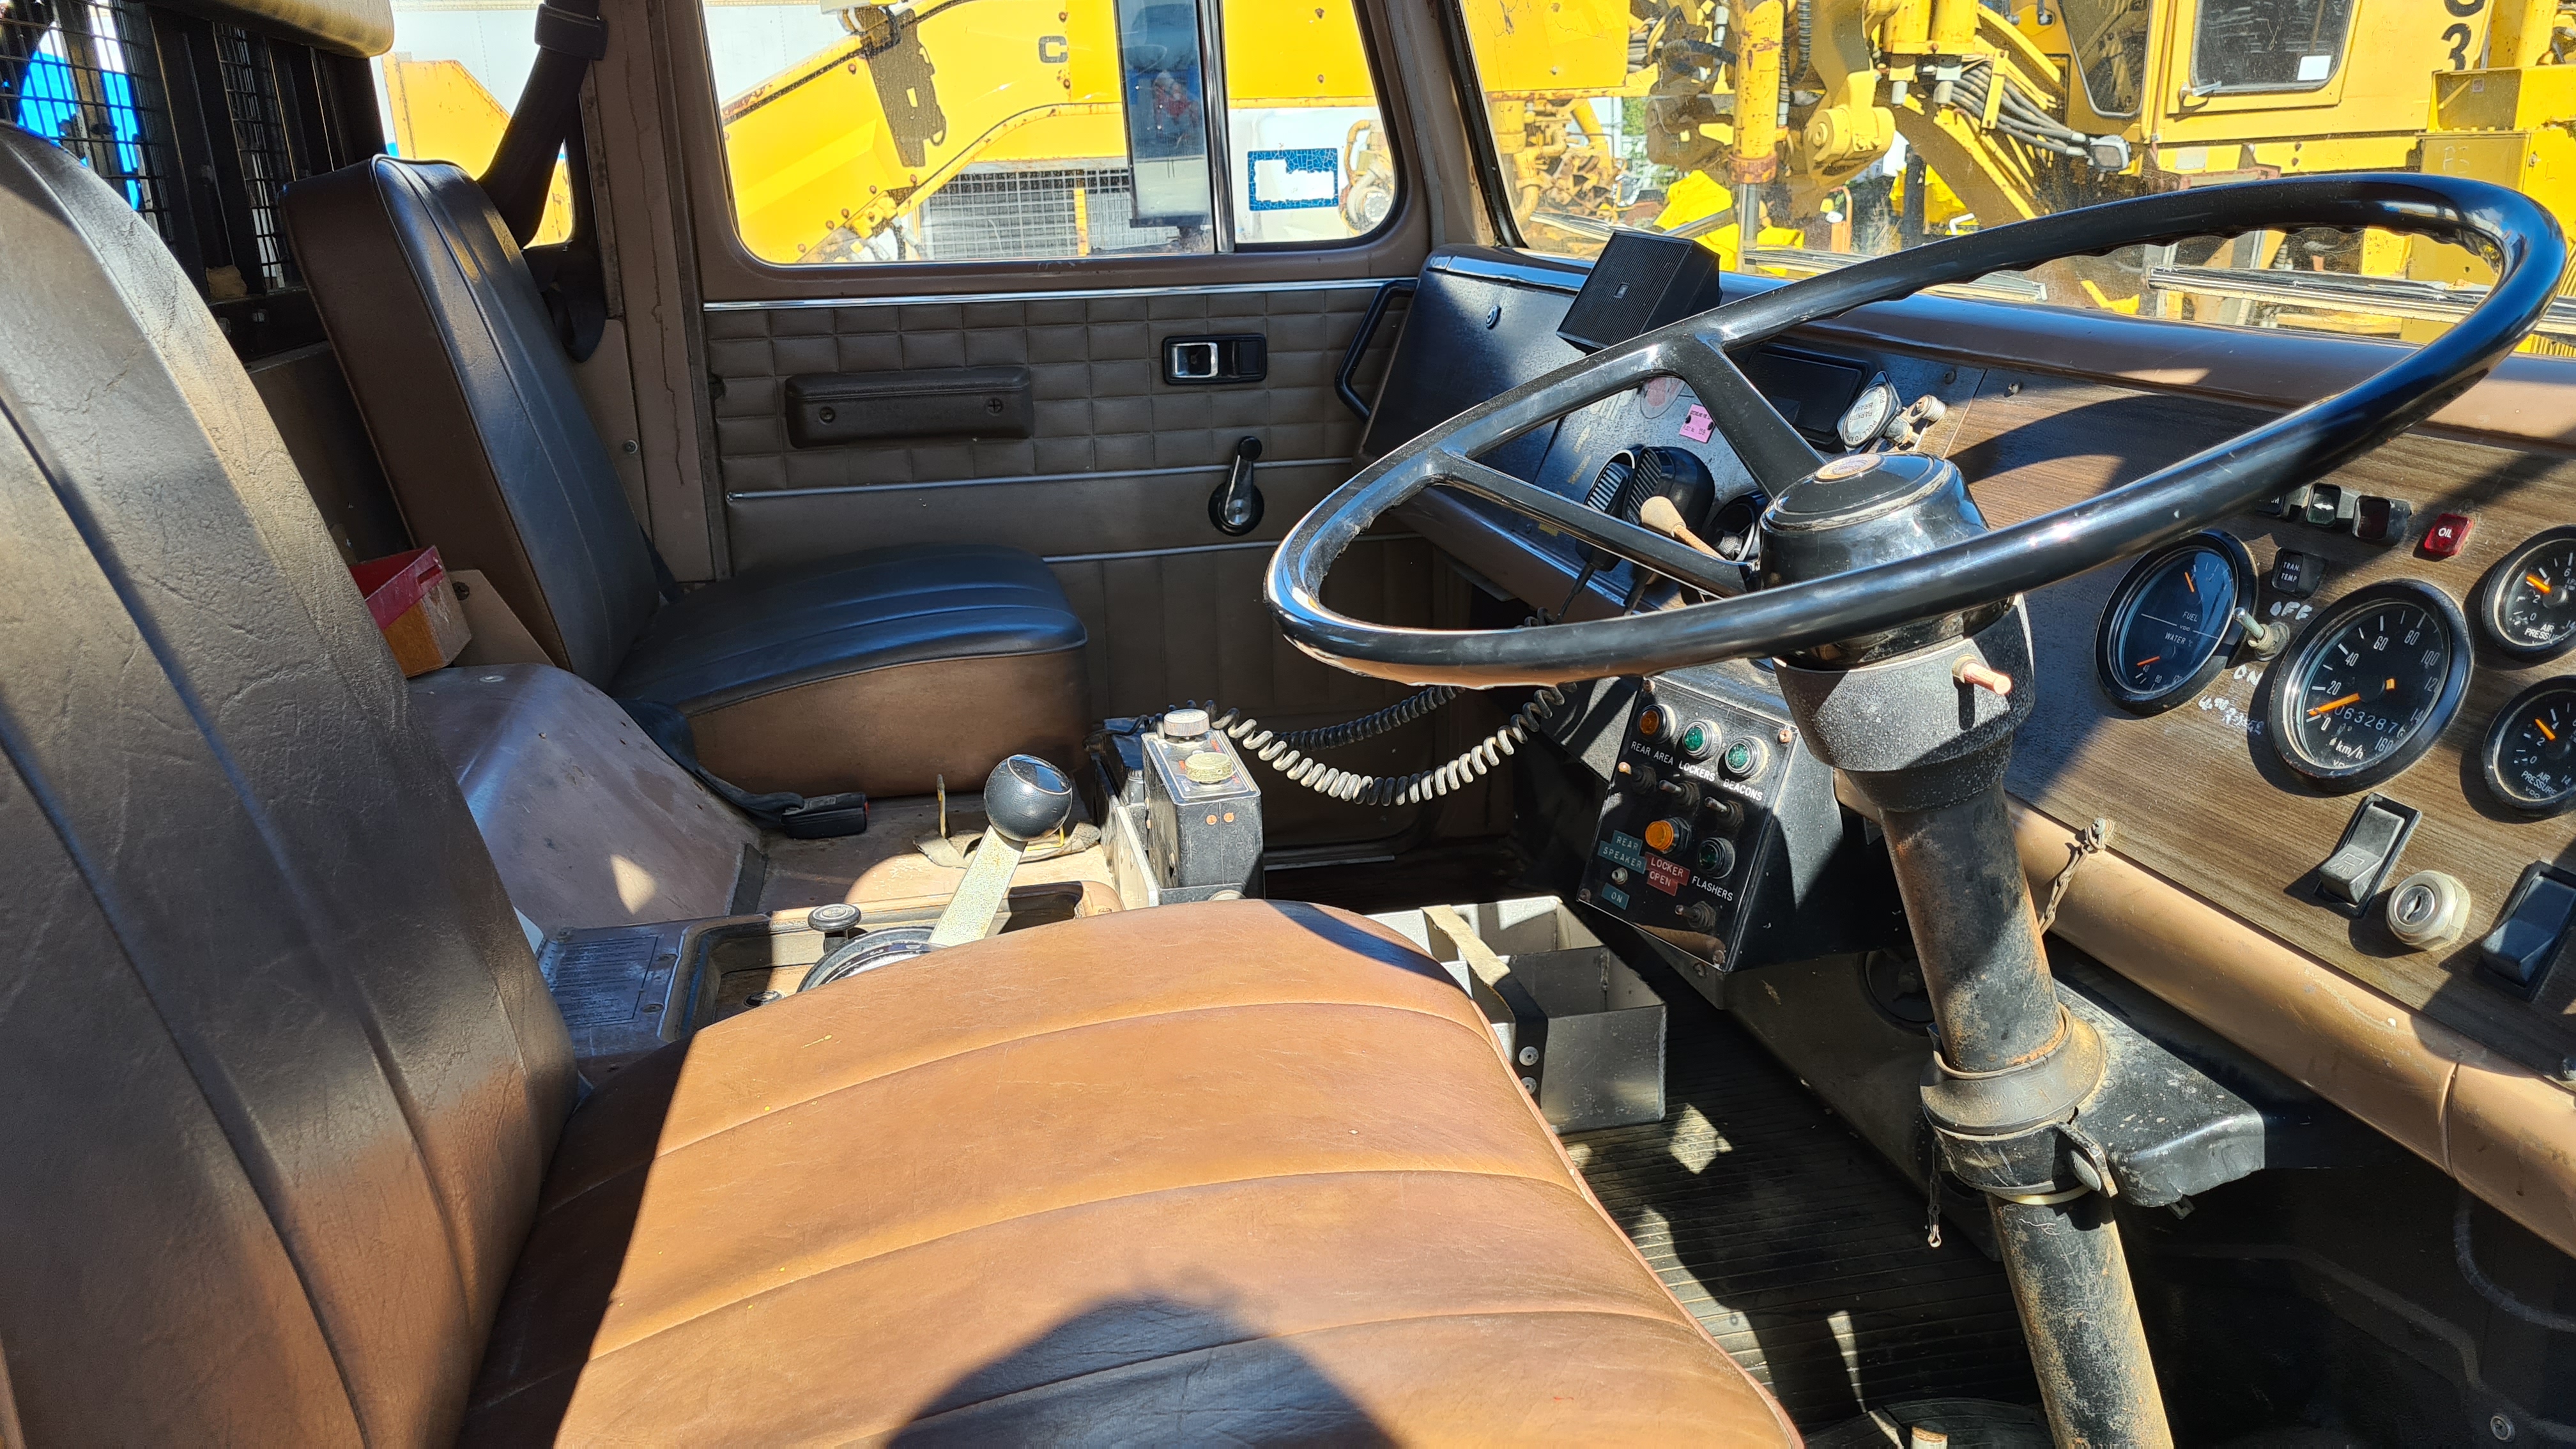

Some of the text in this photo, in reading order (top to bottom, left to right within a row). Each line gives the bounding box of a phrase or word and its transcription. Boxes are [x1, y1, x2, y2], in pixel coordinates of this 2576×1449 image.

[2438, 527, 2452, 538] OIL
[2283, 561, 2301, 572] TRAN
[2564, 568, 2571, 577] 6
[2281, 572, 2297, 583] TEMP
[2533, 594, 2541, 604] 2
[2182, 611, 2198, 622] FUEL
[2530, 613, 2536, 621] 0
[2524, 627, 2561, 640] PRESSU
[2540, 624, 2555, 632] AIR
[2165, 631, 2186, 645] WATER
[2373, 636, 2388, 651] 60
[2404, 630, 2420, 646] 80
[2345, 653, 2359, 667] 40
[2421, 649, 2440, 666] 100
[2233, 664, 2264, 686] ON
[2326, 680, 2342, 695] 20
[2410, 708, 2423, 723] 14
[2321, 717, 2331, 731] 0
[2536, 737, 2545, 746] 2
[1630, 741, 1674, 765] REAR AREA
[2336, 740, 2364, 760] km/h
[2530, 756, 2538, 764] 0
[1678, 760, 1716, 782] LOCKERS
[2536, 771, 2551, 783] AIR
[2521, 770, 2557, 797] PRESSURE
[2561, 775, 2572, 785] 14
[1723, 779, 1763, 801] BEACONS
[2526, 786, 2540, 799] VDO
[1616, 836, 1638, 850] REAR
[1602, 847, 1643, 869] SPEAKER
[1650, 858, 1684, 877] LOCKER
[1649, 871, 1672, 887] OPEN
[1692, 876, 1733, 901] FLASHERS
[1611, 891, 1623, 903] ON
